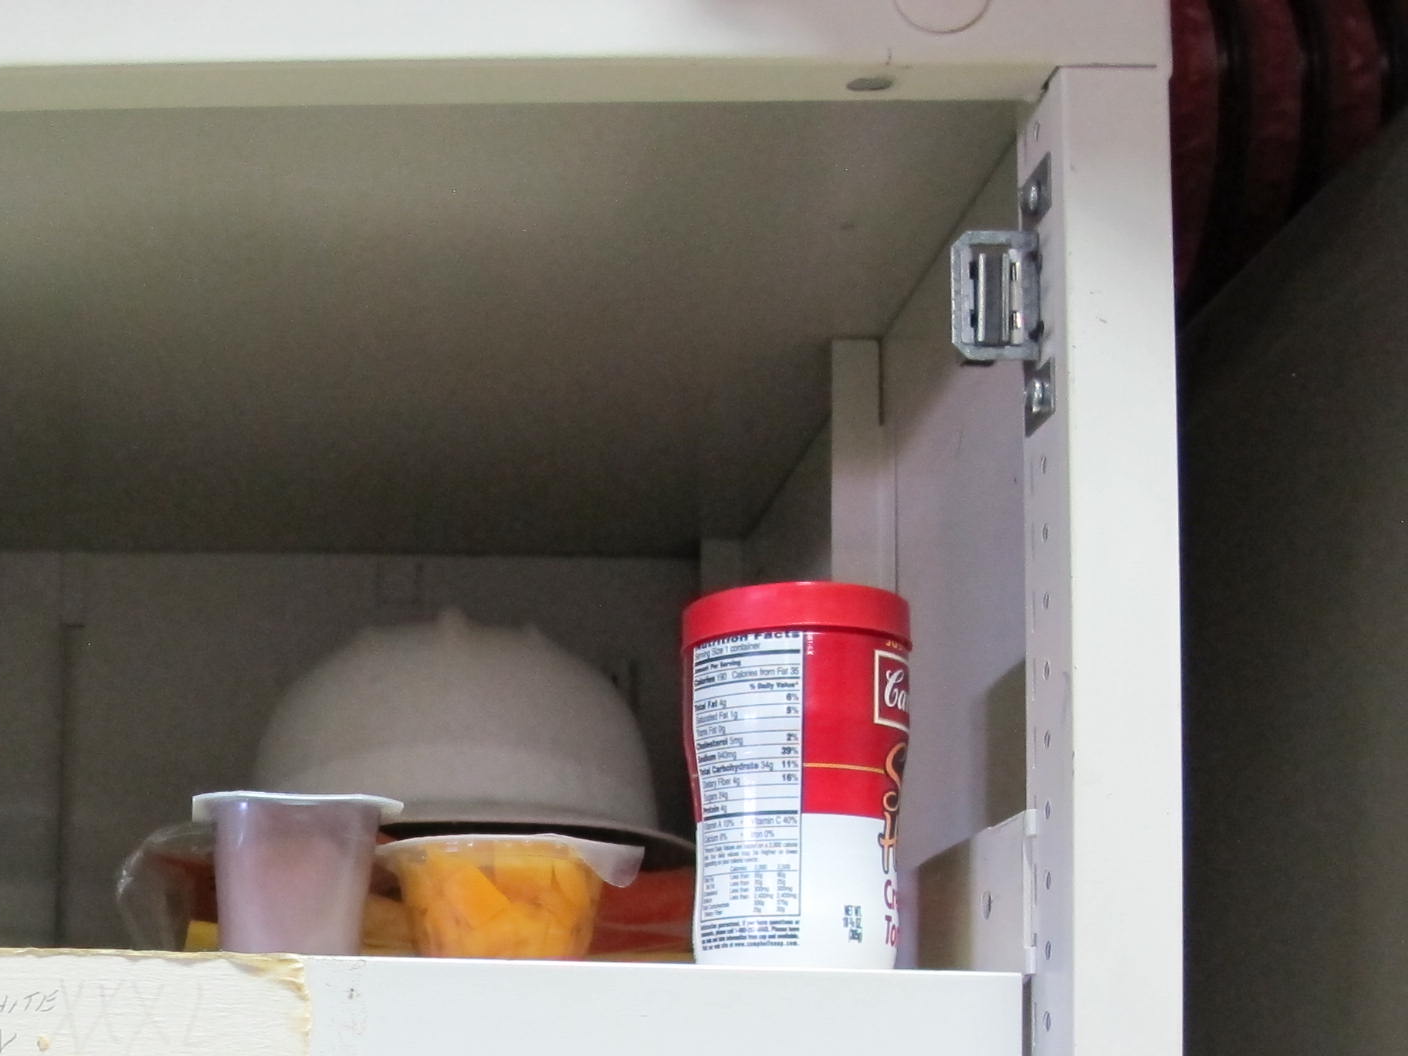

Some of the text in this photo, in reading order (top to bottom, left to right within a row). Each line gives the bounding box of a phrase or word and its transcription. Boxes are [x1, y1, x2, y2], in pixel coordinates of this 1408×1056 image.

[730, 642, 761, 650] container
[732, 669, 758, 679] Calories
[760, 668, 776, 677] from
[777, 666, 789, 674] Fat
[707, 700, 718, 708] Fat
[712, 763, 759, 774] Carbohydrate
